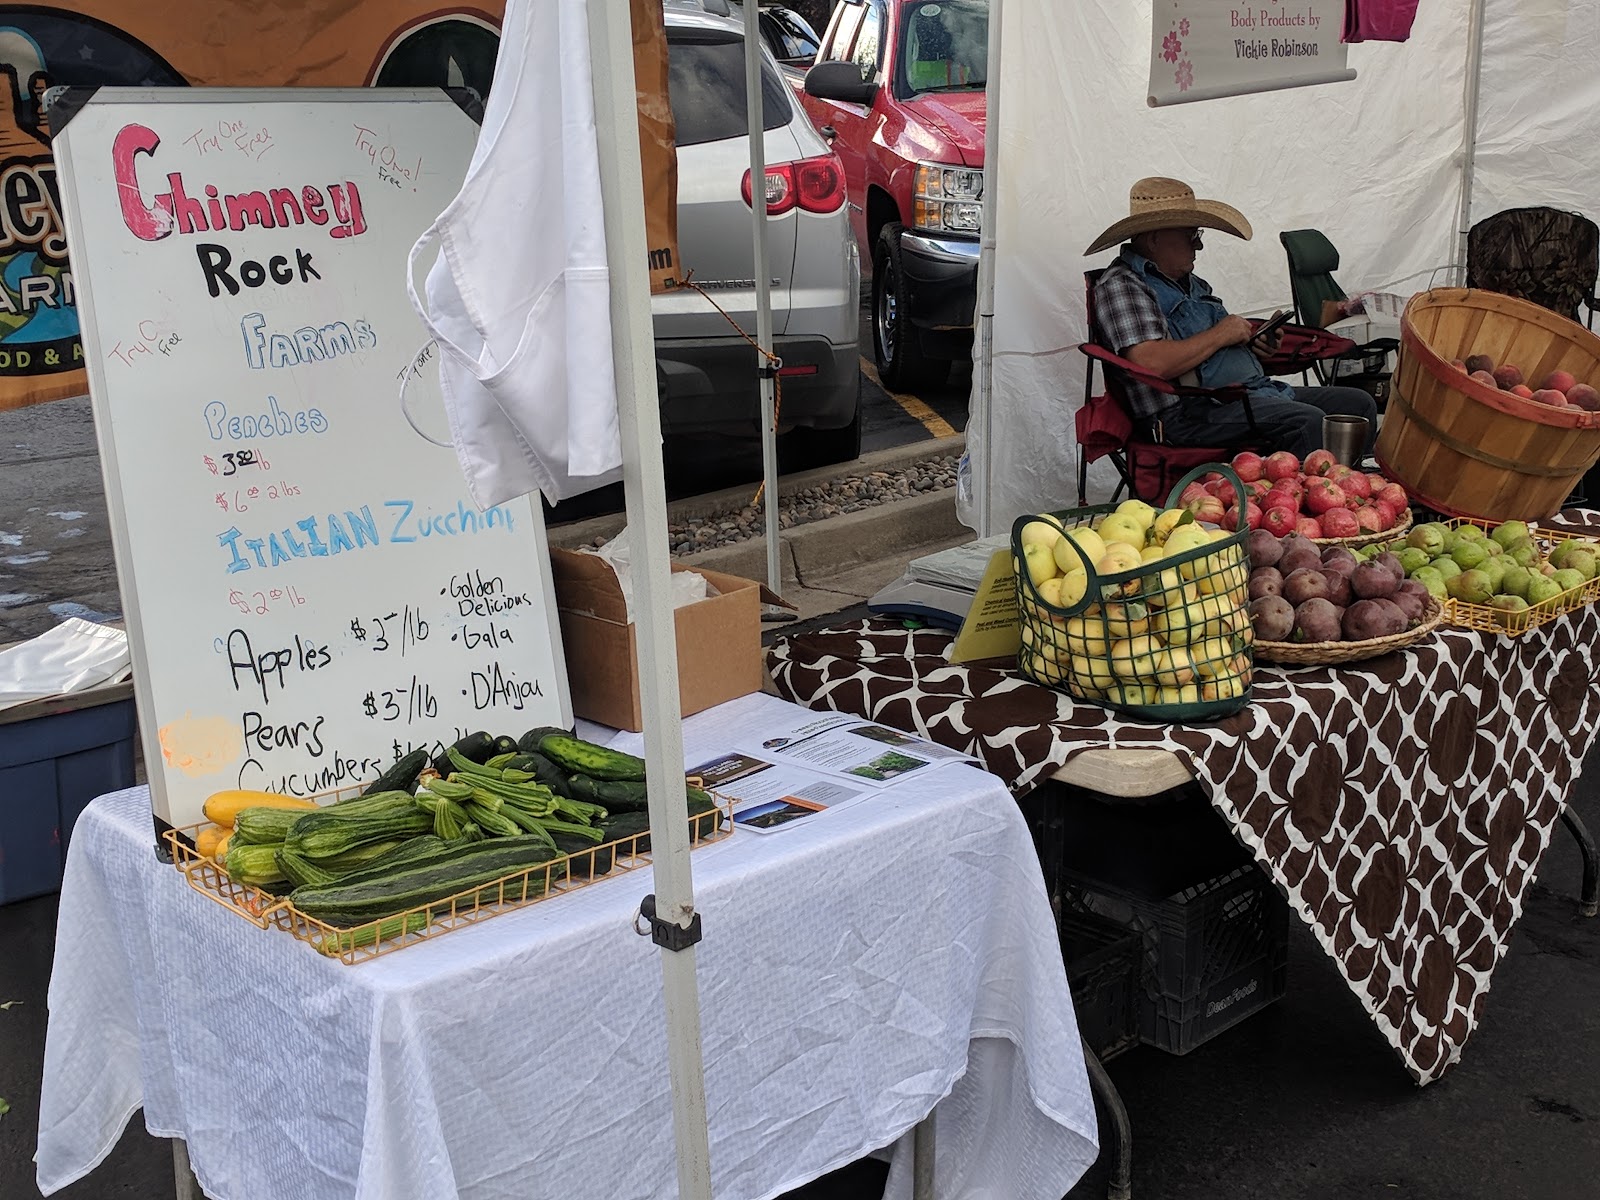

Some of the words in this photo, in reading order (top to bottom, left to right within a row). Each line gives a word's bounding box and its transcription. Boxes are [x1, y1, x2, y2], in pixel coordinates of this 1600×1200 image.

[1230, 8, 1257, 31] Body
[1260, 7, 1305, 27] Products
[1309, 7, 1321, 30] by
[1234, 39, 1268, 60] Vickie
[1271, 38, 1319, 58] Robinson
[182, 128, 223, 156] Try
[218, 119, 245, 139] One
[234, 128, 272, 157] Free
[353, 123, 378, 165] Try
[112, 122, 368, 242] Chimney
[377, 166, 402, 189] Free
[196, 243, 322, 299] Rock
[45, 348, 60, 364] &
[107, 340, 154, 368] Try
[158, 332, 183, 357] Free
[280, 480, 302, 497] lbs
[285, 585, 306, 608] lb
[458, 592, 533, 617] Delicious
[463, 622, 515, 650] Gala
[227, 628, 332, 705] Apples
[243, 711, 325, 758] Pears
[470, 661, 545, 710] D'Anjou
